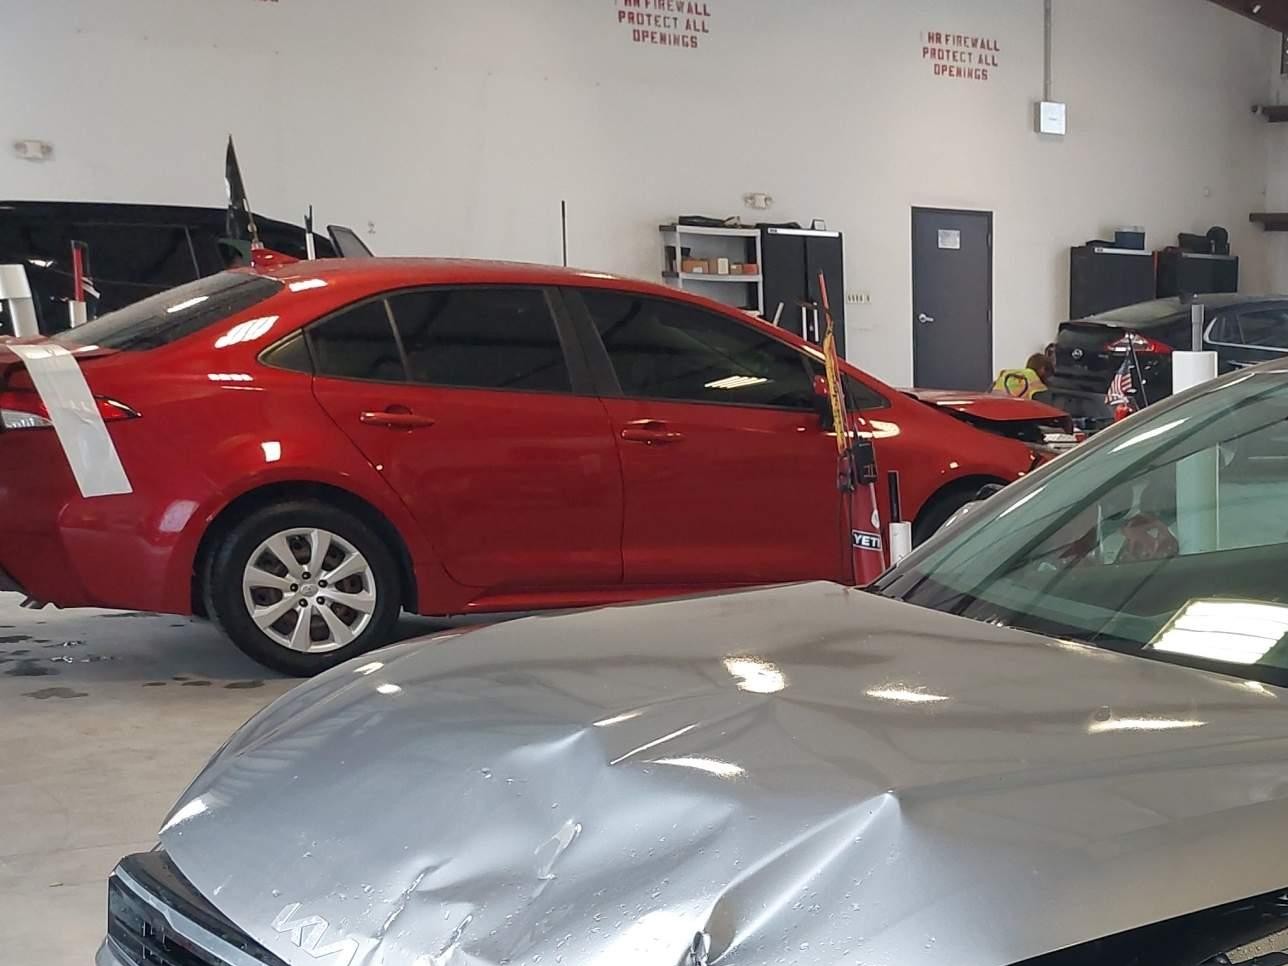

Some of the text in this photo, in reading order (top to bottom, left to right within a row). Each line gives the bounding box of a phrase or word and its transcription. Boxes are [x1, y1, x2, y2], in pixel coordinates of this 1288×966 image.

[618, 10, 709, 33] PROTECT ALL
[633, 29, 698, 48] OPENINGS
[945, 34, 1000, 51] FIREWALL
[923, 47, 998, 67] PROTECT ALL
[934, 63, 988, 80] OPENINGS
[854, 533, 880, 548] YETI
